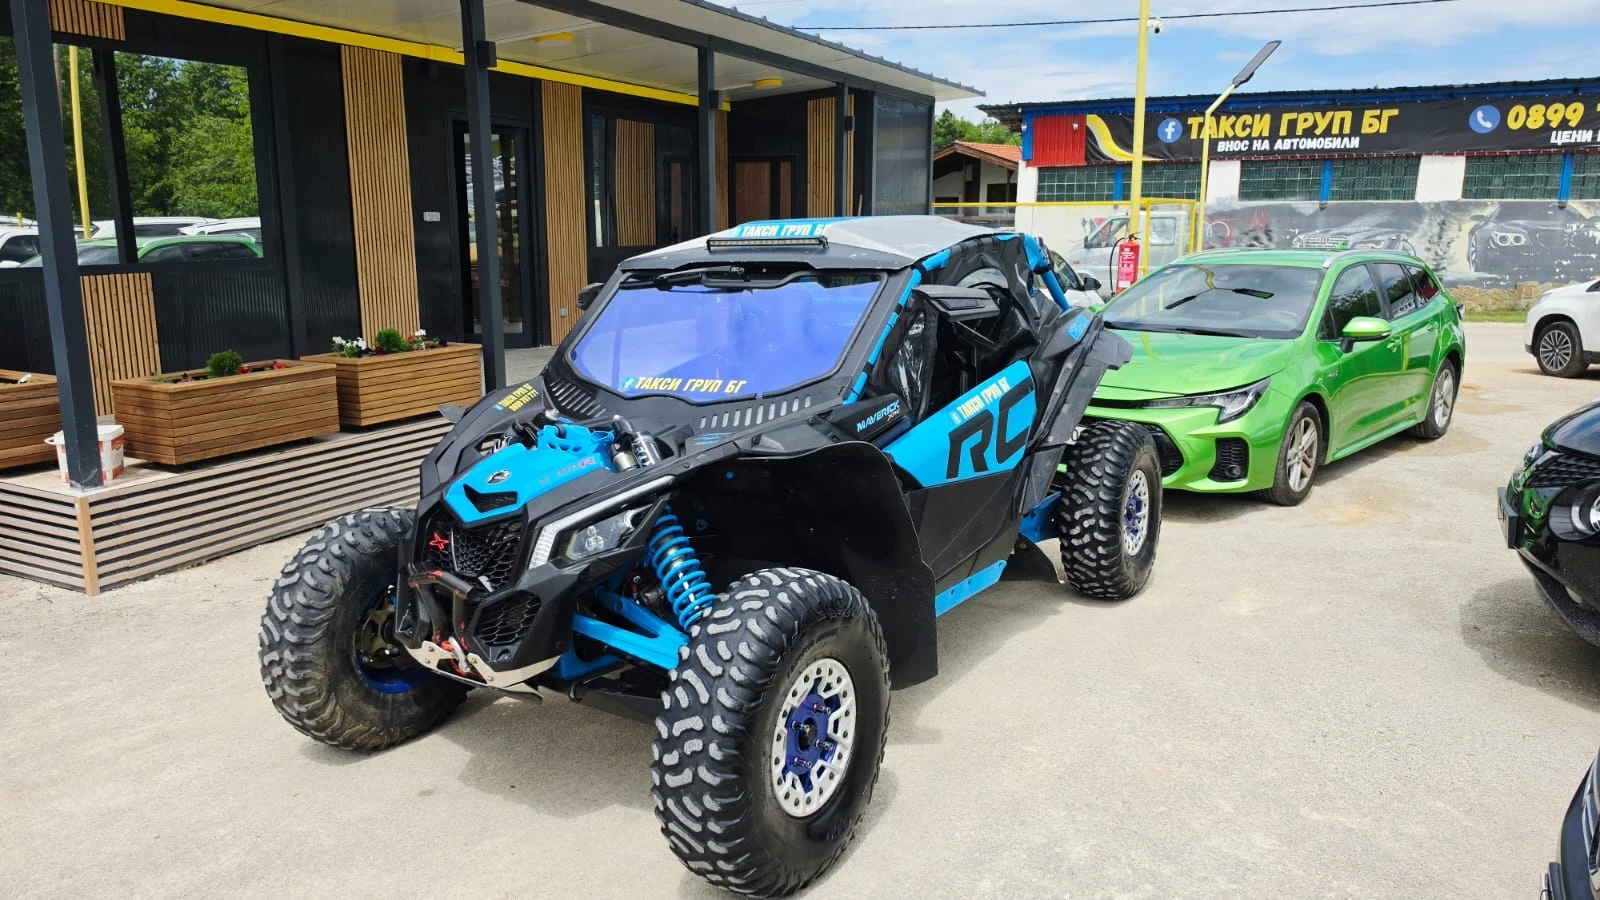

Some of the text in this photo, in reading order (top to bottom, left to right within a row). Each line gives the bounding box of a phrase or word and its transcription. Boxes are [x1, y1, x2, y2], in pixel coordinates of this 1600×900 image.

[1187, 109, 1399, 140] ТАКСИ ГРУП БГ
[1507, 102, 1585, 130] 0899
[1217, 136, 1361, 153] ВНОС НА АВТОМОБИЛИ
[1550, 129, 1593, 146] ЦЕНИ
[742, 225, 779, 237] ТАКСИ
[781, 224, 813, 237] ГРУП
[635, 376, 747, 394] ТАКСИ ГРУП БГ
[957, 394, 985, 420] ТАКСИ
[980, 383, 1003, 405] ГРУП
[856, 399, 900, 433] MAVERICK
[946, 375, 1035, 480] RC
